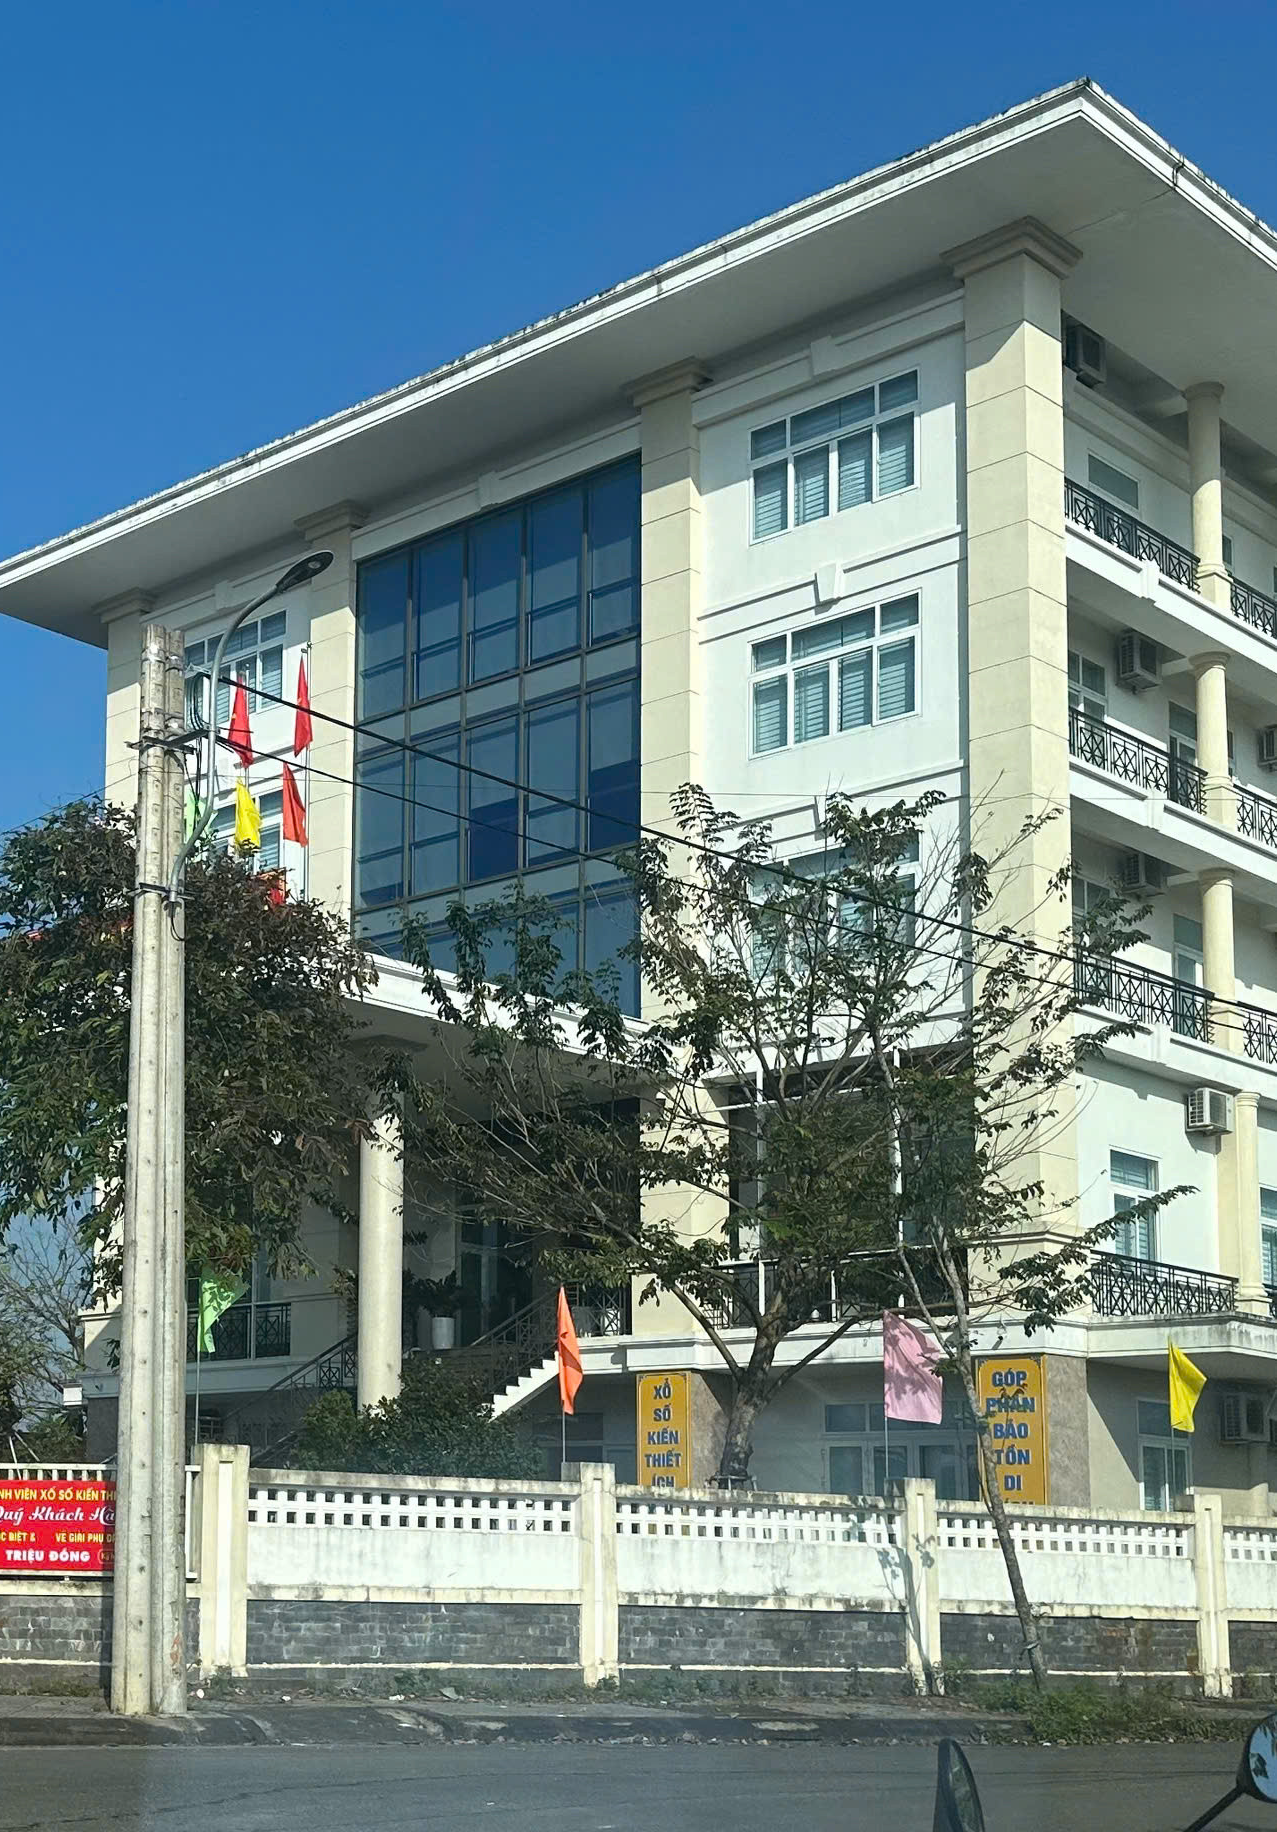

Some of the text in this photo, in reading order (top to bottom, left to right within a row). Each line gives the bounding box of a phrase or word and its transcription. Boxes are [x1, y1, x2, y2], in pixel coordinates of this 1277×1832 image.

[991, 1367, 1027, 1387] GÓP
[653, 1377, 672, 1399] XỔ
[653, 1403, 672, 1422] SỐ
[647, 1426, 679, 1445] KIẾN
[993, 1418, 1029, 1439] BẢO
[644, 1447, 682, 1468] THIẾT
[1004, 1474, 1022, 1491] DI
[14, 1487, 37, 1500] VIÊN
[40, 1485, 56, 1500] XỔ
[58, 1486, 73, 1500] SỐ
[76, 1486, 99, 1500] KIẾN
[28, 1506, 83, 1521] Khách
[8, 1531, 28, 1543] BIỆT
[30, 1533, 36, 1542] &
[55, 1531, 67, 1542] VÉ
[69, 1531, 85, 1543] GIẢI
[87, 1532, 104, 1544] PHỤ
[5, 1548, 44, 1564] TRIỆU
[48, 1547, 90, 1562] ĐỒNG
